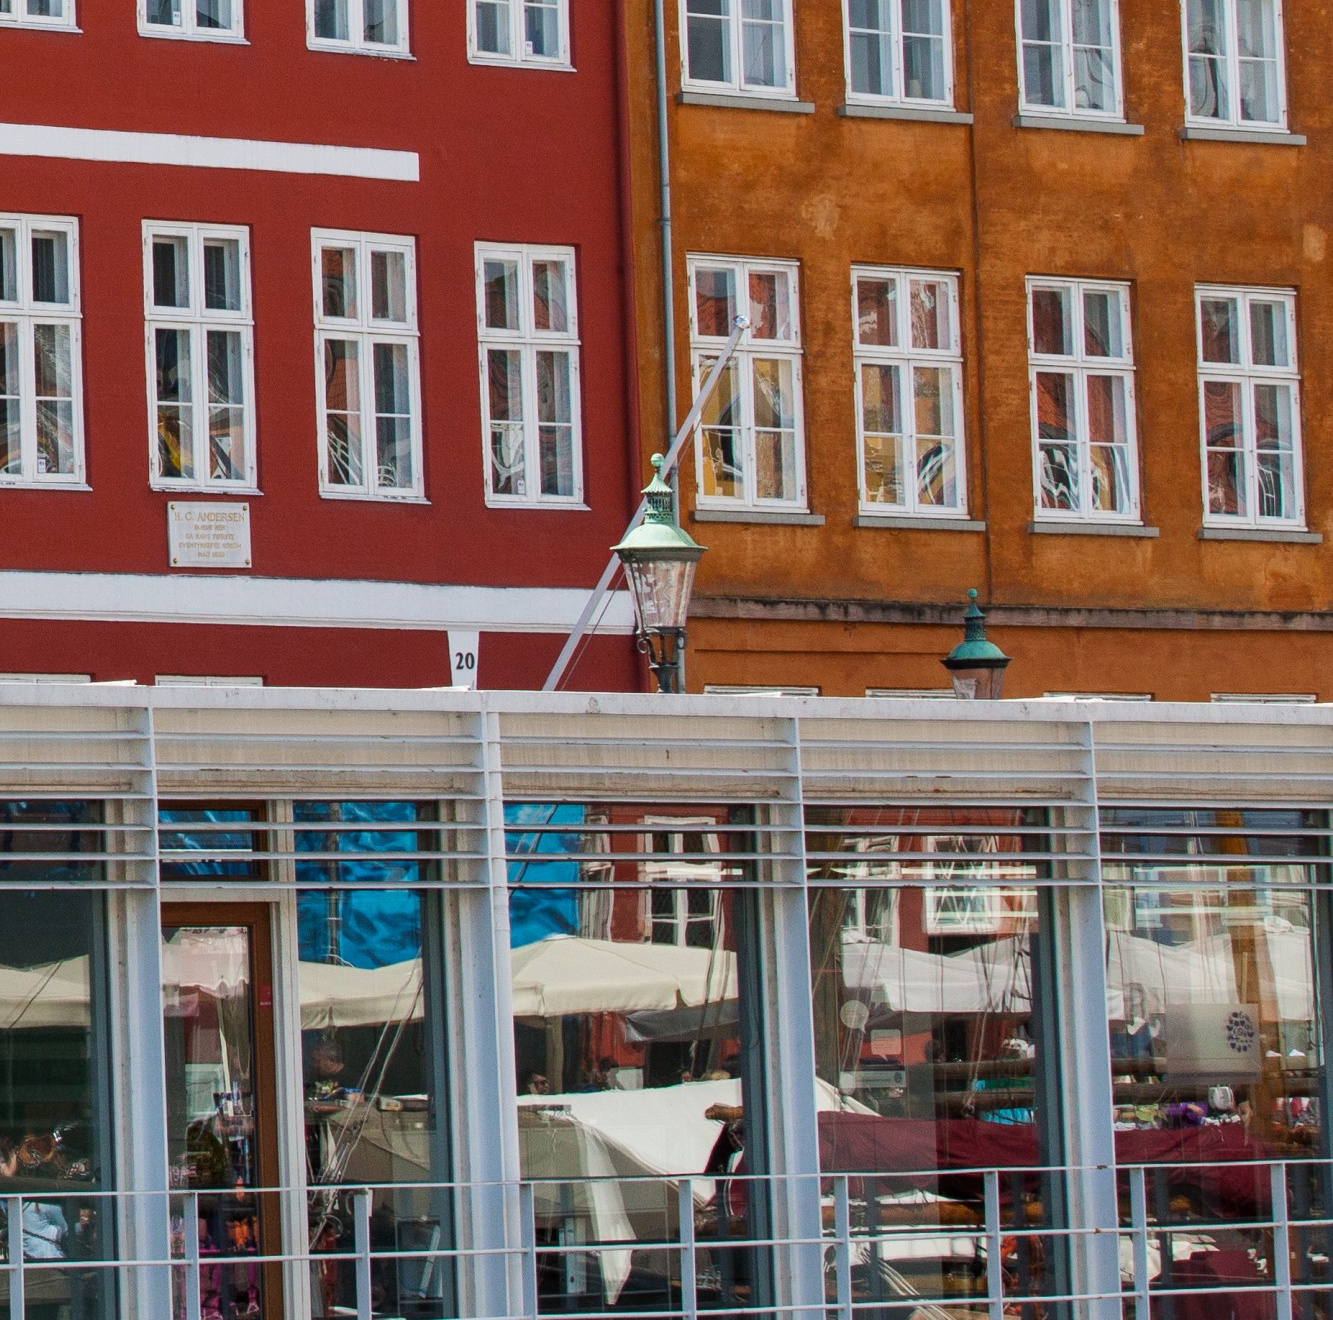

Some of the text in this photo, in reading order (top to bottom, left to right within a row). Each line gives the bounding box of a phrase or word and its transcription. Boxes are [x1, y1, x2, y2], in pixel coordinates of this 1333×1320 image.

[185, 512, 194, 521] C.
[197, 512, 245, 522] ANDERSEN
[455, 652, 475, 670] 20
